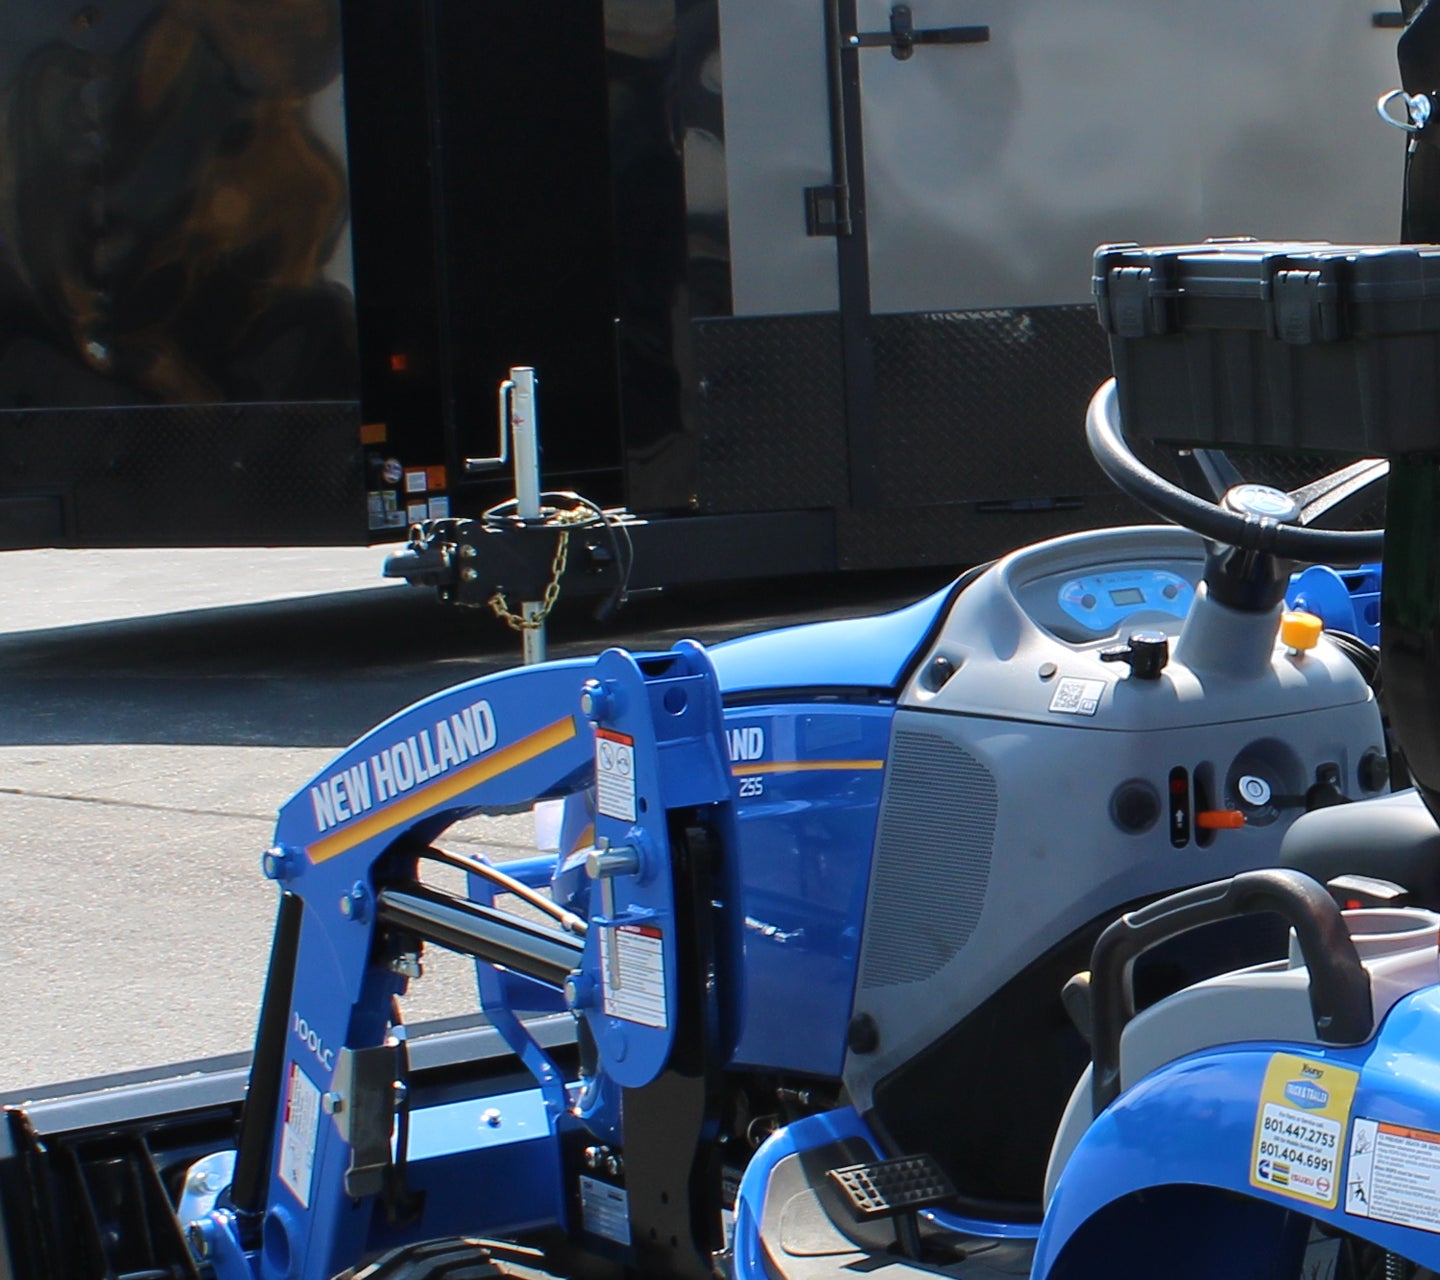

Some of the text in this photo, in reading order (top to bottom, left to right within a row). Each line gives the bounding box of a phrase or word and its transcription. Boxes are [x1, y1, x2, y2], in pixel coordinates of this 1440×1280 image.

[311, 761, 372, 833] NEW
[371, 699, 498, 803] HOLLAND
[293, 1011, 335, 1072] 100LC
[1301, 1063, 1324, 1080] Young
[1264, 1117, 1335, 1148] 801.447.2753
[1260, 1141, 1333, 1173] 801.404.6991
